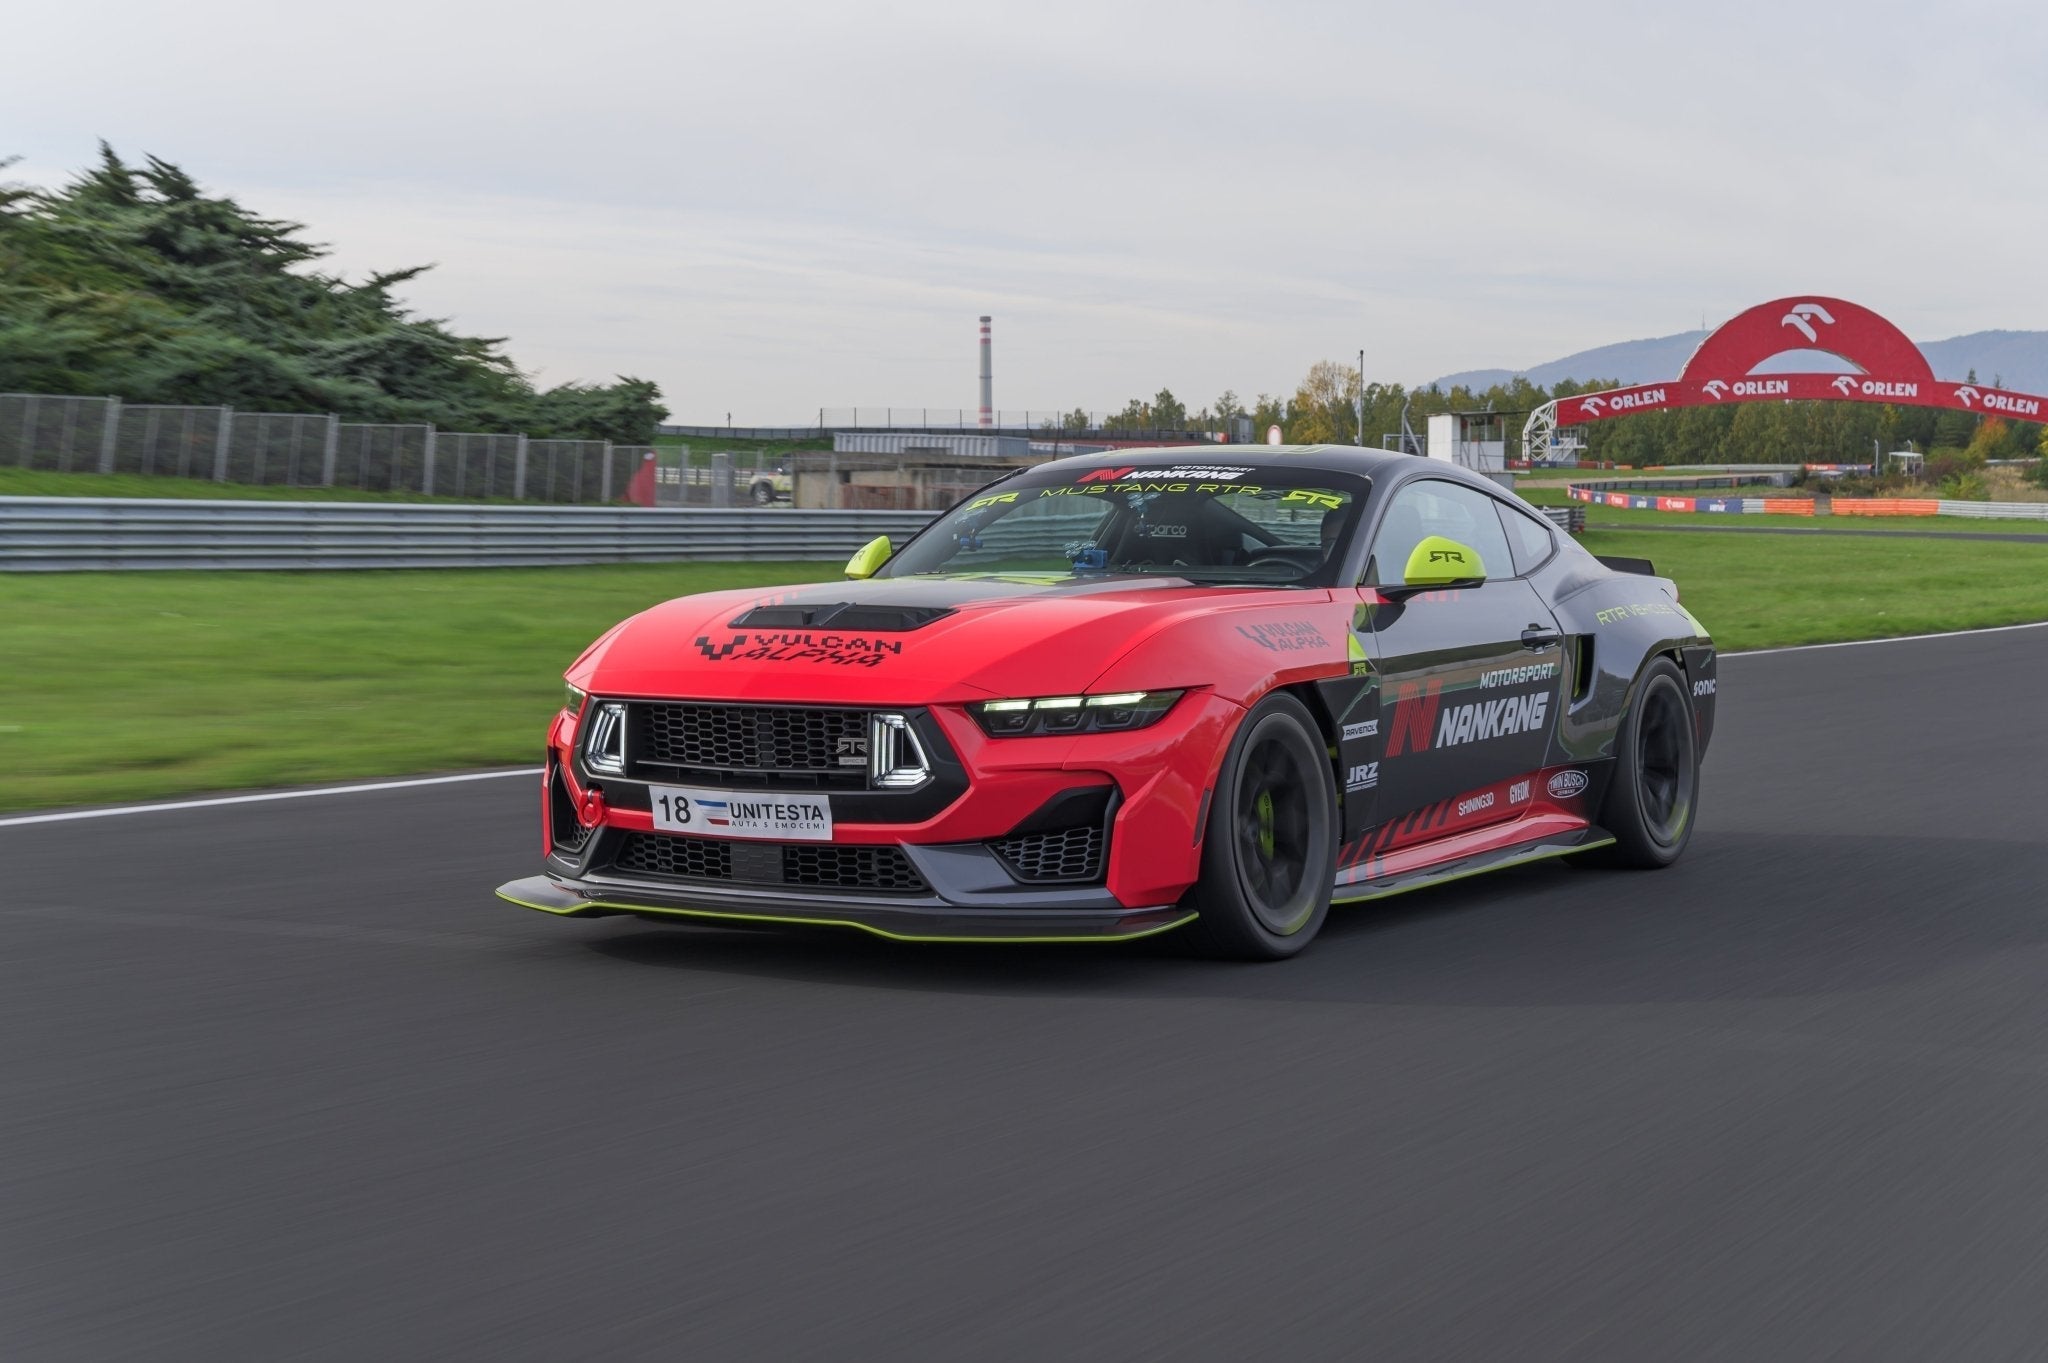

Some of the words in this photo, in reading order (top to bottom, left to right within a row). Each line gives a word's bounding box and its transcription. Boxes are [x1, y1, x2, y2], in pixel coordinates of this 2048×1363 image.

[1732, 380, 1788, 395] ORLEN
[1861, 381, 1917, 397] ORLEN
[1610, 389, 1666, 410] ORLEN
[1983, 394, 2039, 415] ORLEN
[1121, 470, 1245, 480] NANKANG
[1040, 483, 1190, 498] MUSTANG
[1195, 484, 1262, 495] RTR
[1595, 606, 1630, 626] RTR
[755, 634, 902, 654] VULCAN
[730, 646, 885, 667] ALPHA
[1480, 662, 1555, 690] MOTORSPORT
[1435, 691, 1550, 749] NANKANG
[1346, 761, 1378, 784] JRZ
[658, 794, 692, 824] 18
[730, 802, 825, 821] UNITESTA
[1458, 791, 1495, 816] SHINING3D
[731, 820, 758, 828] AUTA
[764, 820, 769, 829] S
[775, 822, 826, 830] EMOCEMI
